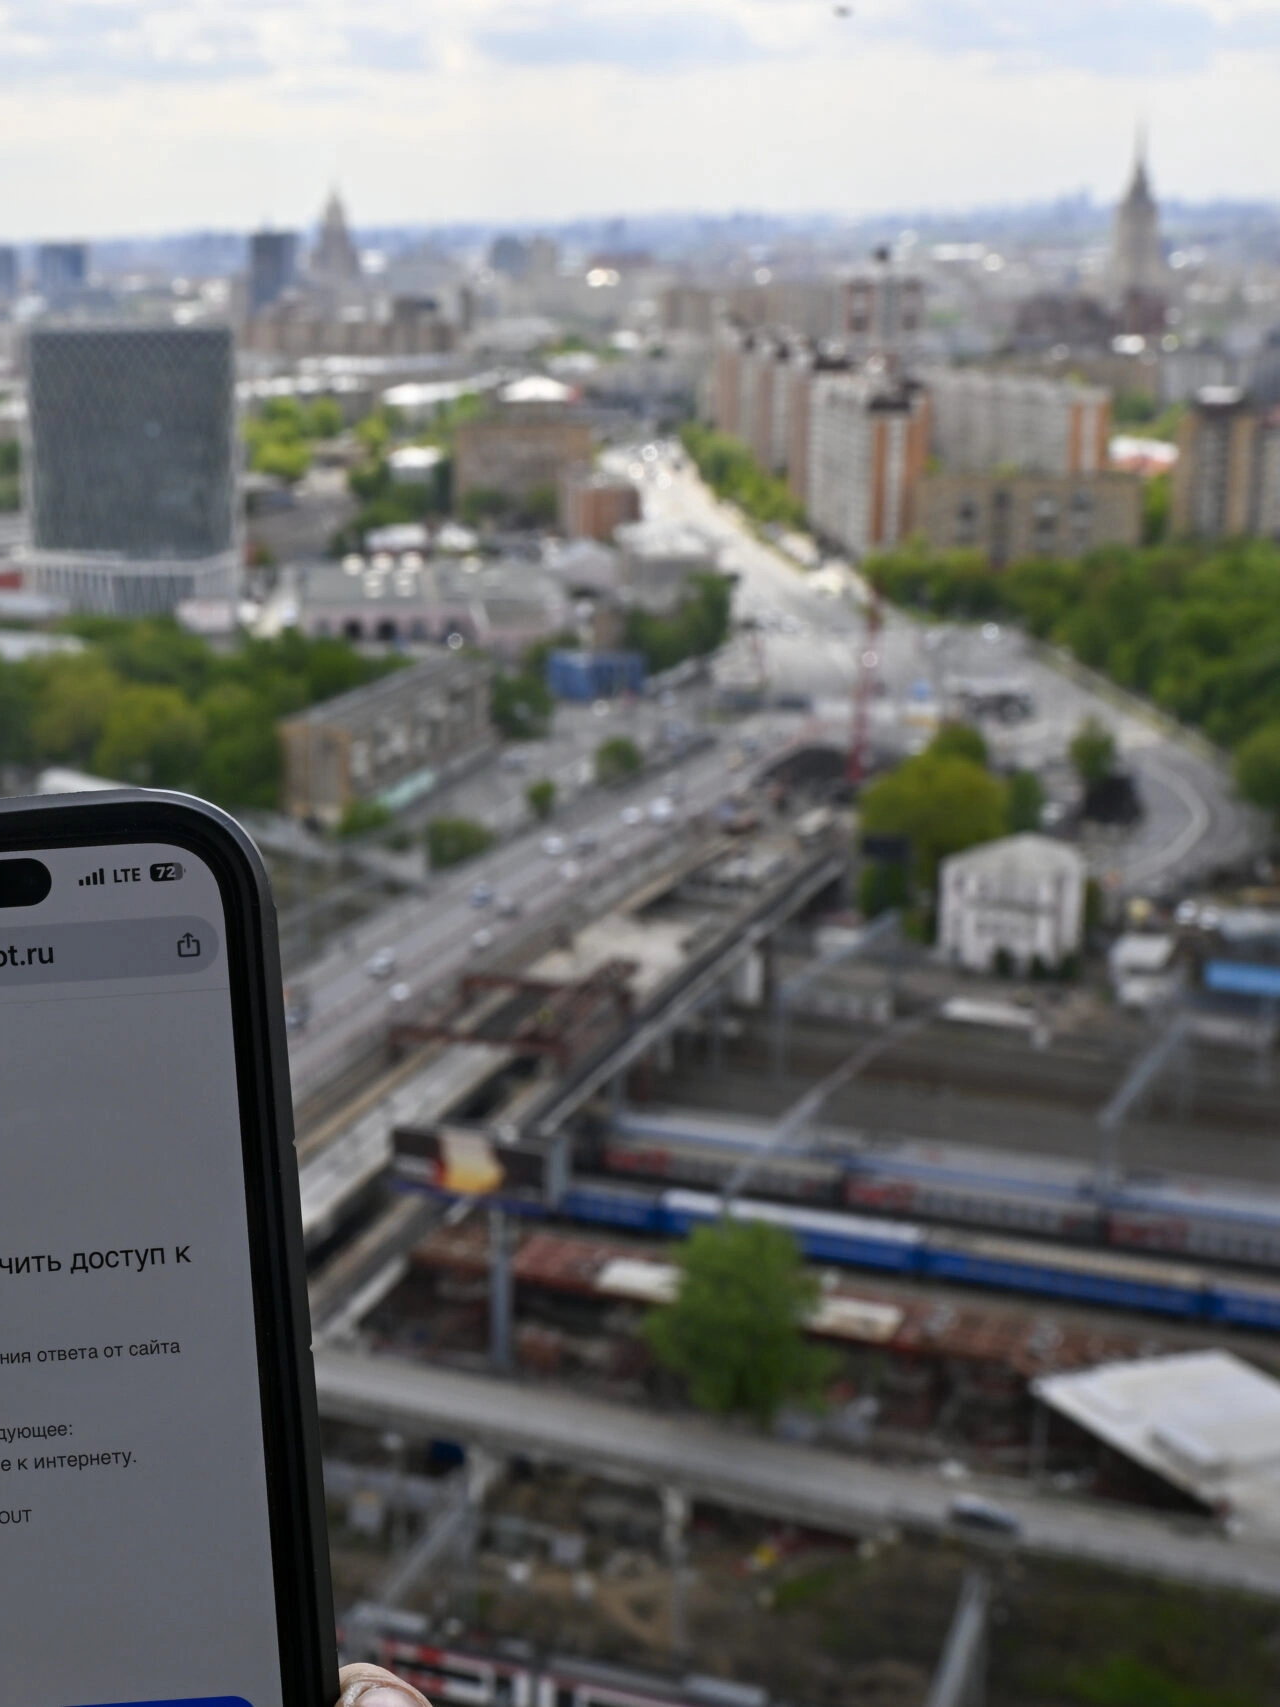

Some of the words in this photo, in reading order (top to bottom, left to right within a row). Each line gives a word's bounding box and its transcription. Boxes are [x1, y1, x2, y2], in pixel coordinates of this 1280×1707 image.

[113, 867, 141, 883] LTE
[155, 866, 176, 879] 72
[70, 1248, 165, 1274] доступ
[176, 1246, 192, 1263] к
[37, 1347, 98, 1362] ответа
[104, 1345, 123, 1358] от
[129, 1340, 180, 1356] сайта
[18, 1458, 28, 1471] к
[34, 1451, 136, 1471] интернету.
